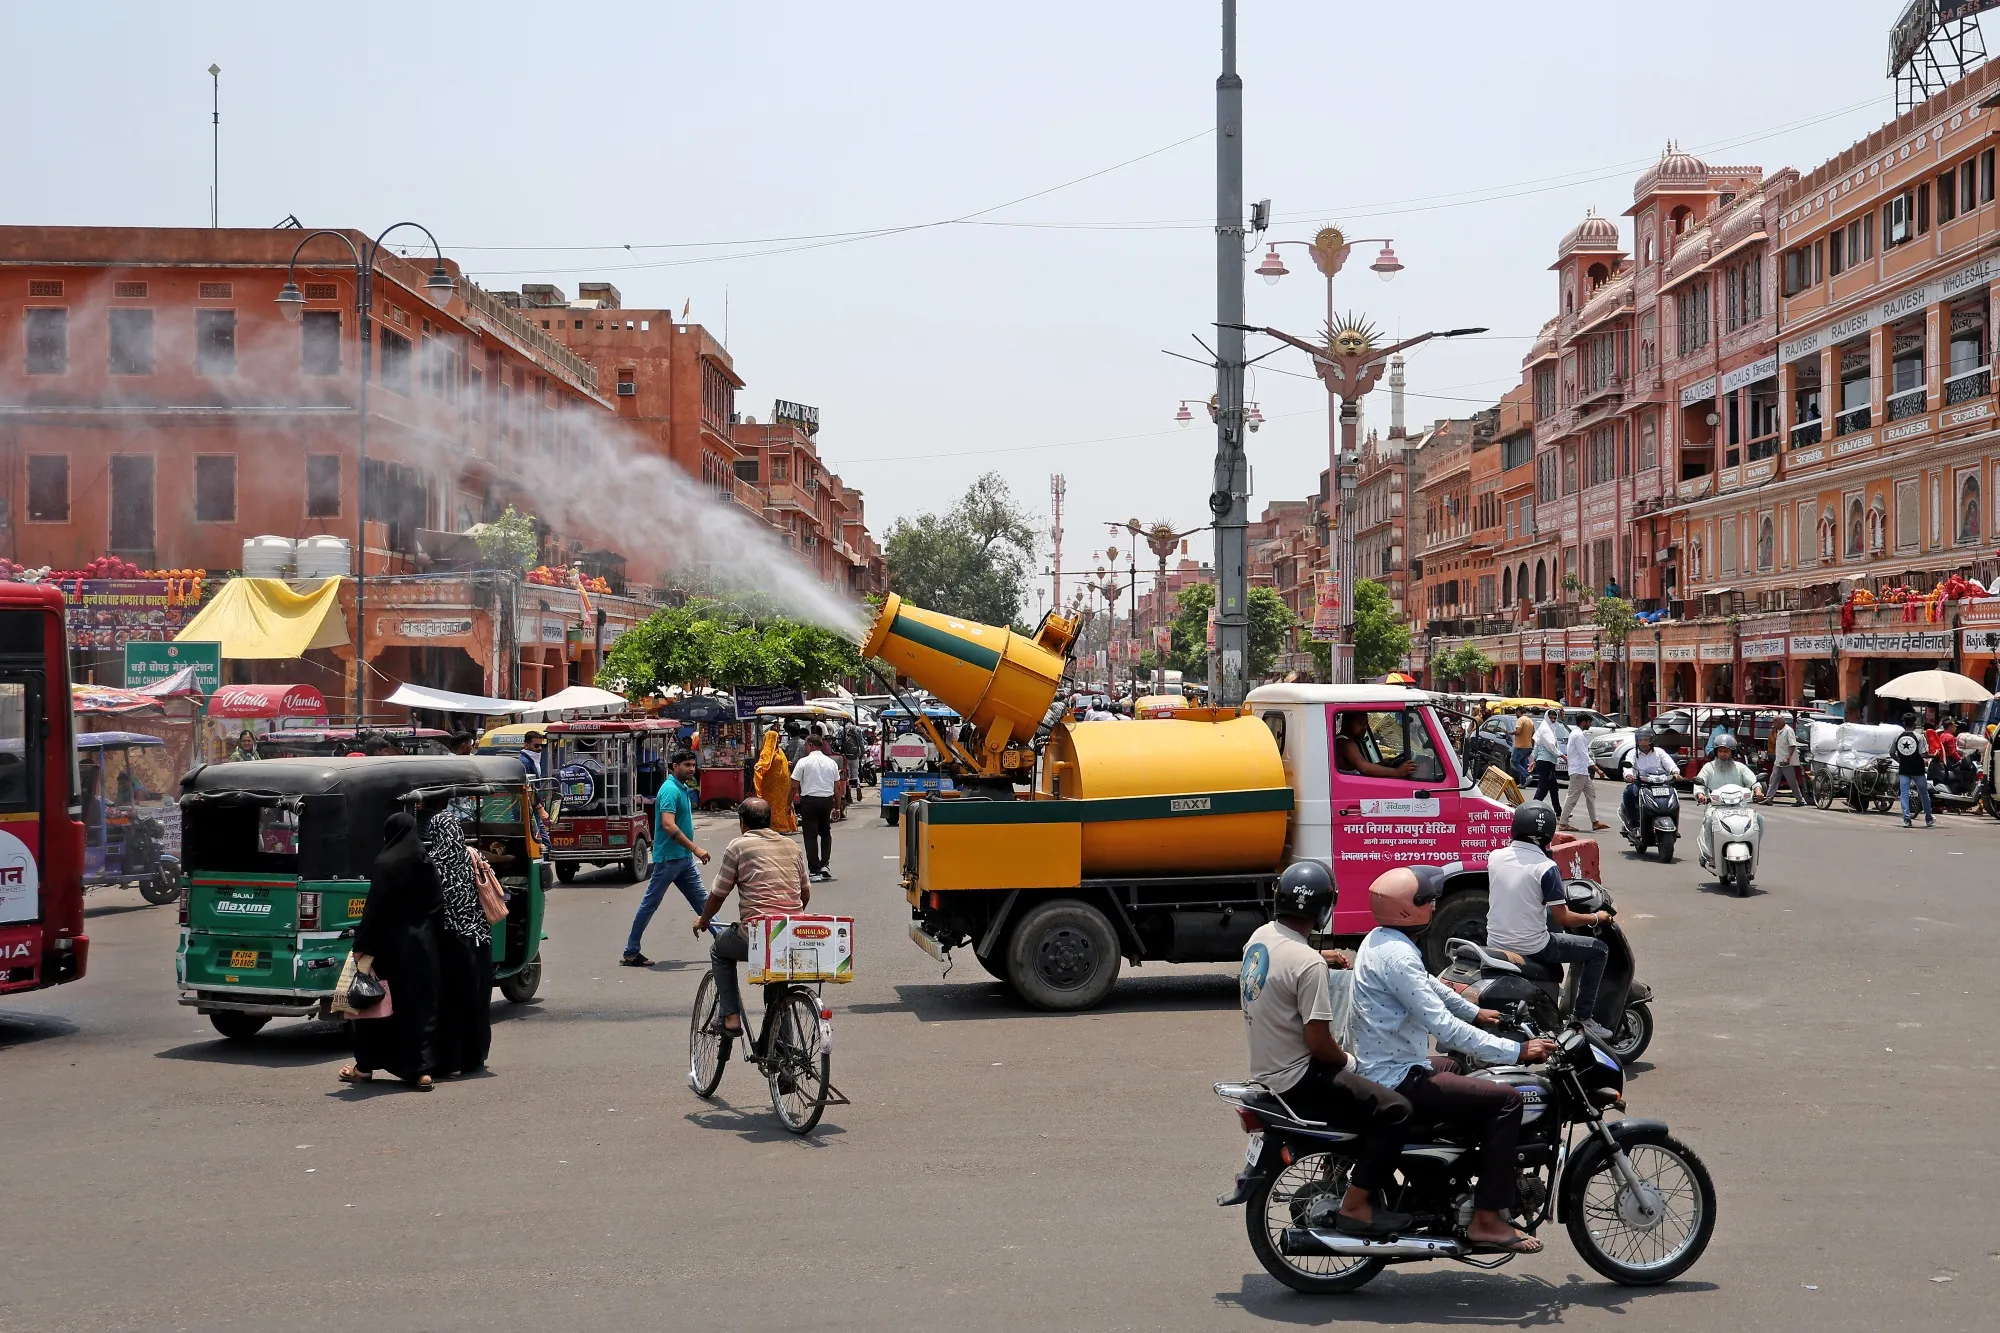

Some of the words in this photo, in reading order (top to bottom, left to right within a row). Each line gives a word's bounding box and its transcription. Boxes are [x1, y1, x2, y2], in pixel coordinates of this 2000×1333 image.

[1943, 261, 1990, 293] WHOLESALE
[1883, 289, 1925, 318] RAJVESH
[1831, 314, 1868, 339] RAJVESH
[1785, 335, 1818, 359] RAJVESH
[1724, 368, 1750, 390] JINDALS
[1684, 380, 1714, 403] RAJVESH
[778, 400, 800, 419] AARI
[1888, 421, 1929, 439] RAJVESH
[1838, 435, 1872, 452] RAJVESH
[128, 677, 141, 685] BADI
[222, 691, 269, 708] Vanila
[284, 693, 322, 708] Vanila
[1172, 799, 1208, 810] BAXY
[1468, 809, 1490, 823] गुलाबी
[1343, 824, 1364, 834] नगर
[1366, 821, 1393, 834] निगम
[1394, 824, 1424, 837] जयपुर
[1467, 823, 1486, 834] हमारी
[553, 837, 574, 846] STOP
[1379, 838, 1397, 846] जयपुर
[1419, 838, 1436, 846] जयपुर
[1490, 836, 1497, 848] से
[1394, 852, 1459, 861] 8279179065
[217, 901, 272, 914] Maxima
[796, 928, 829, 936] MAHALASA
